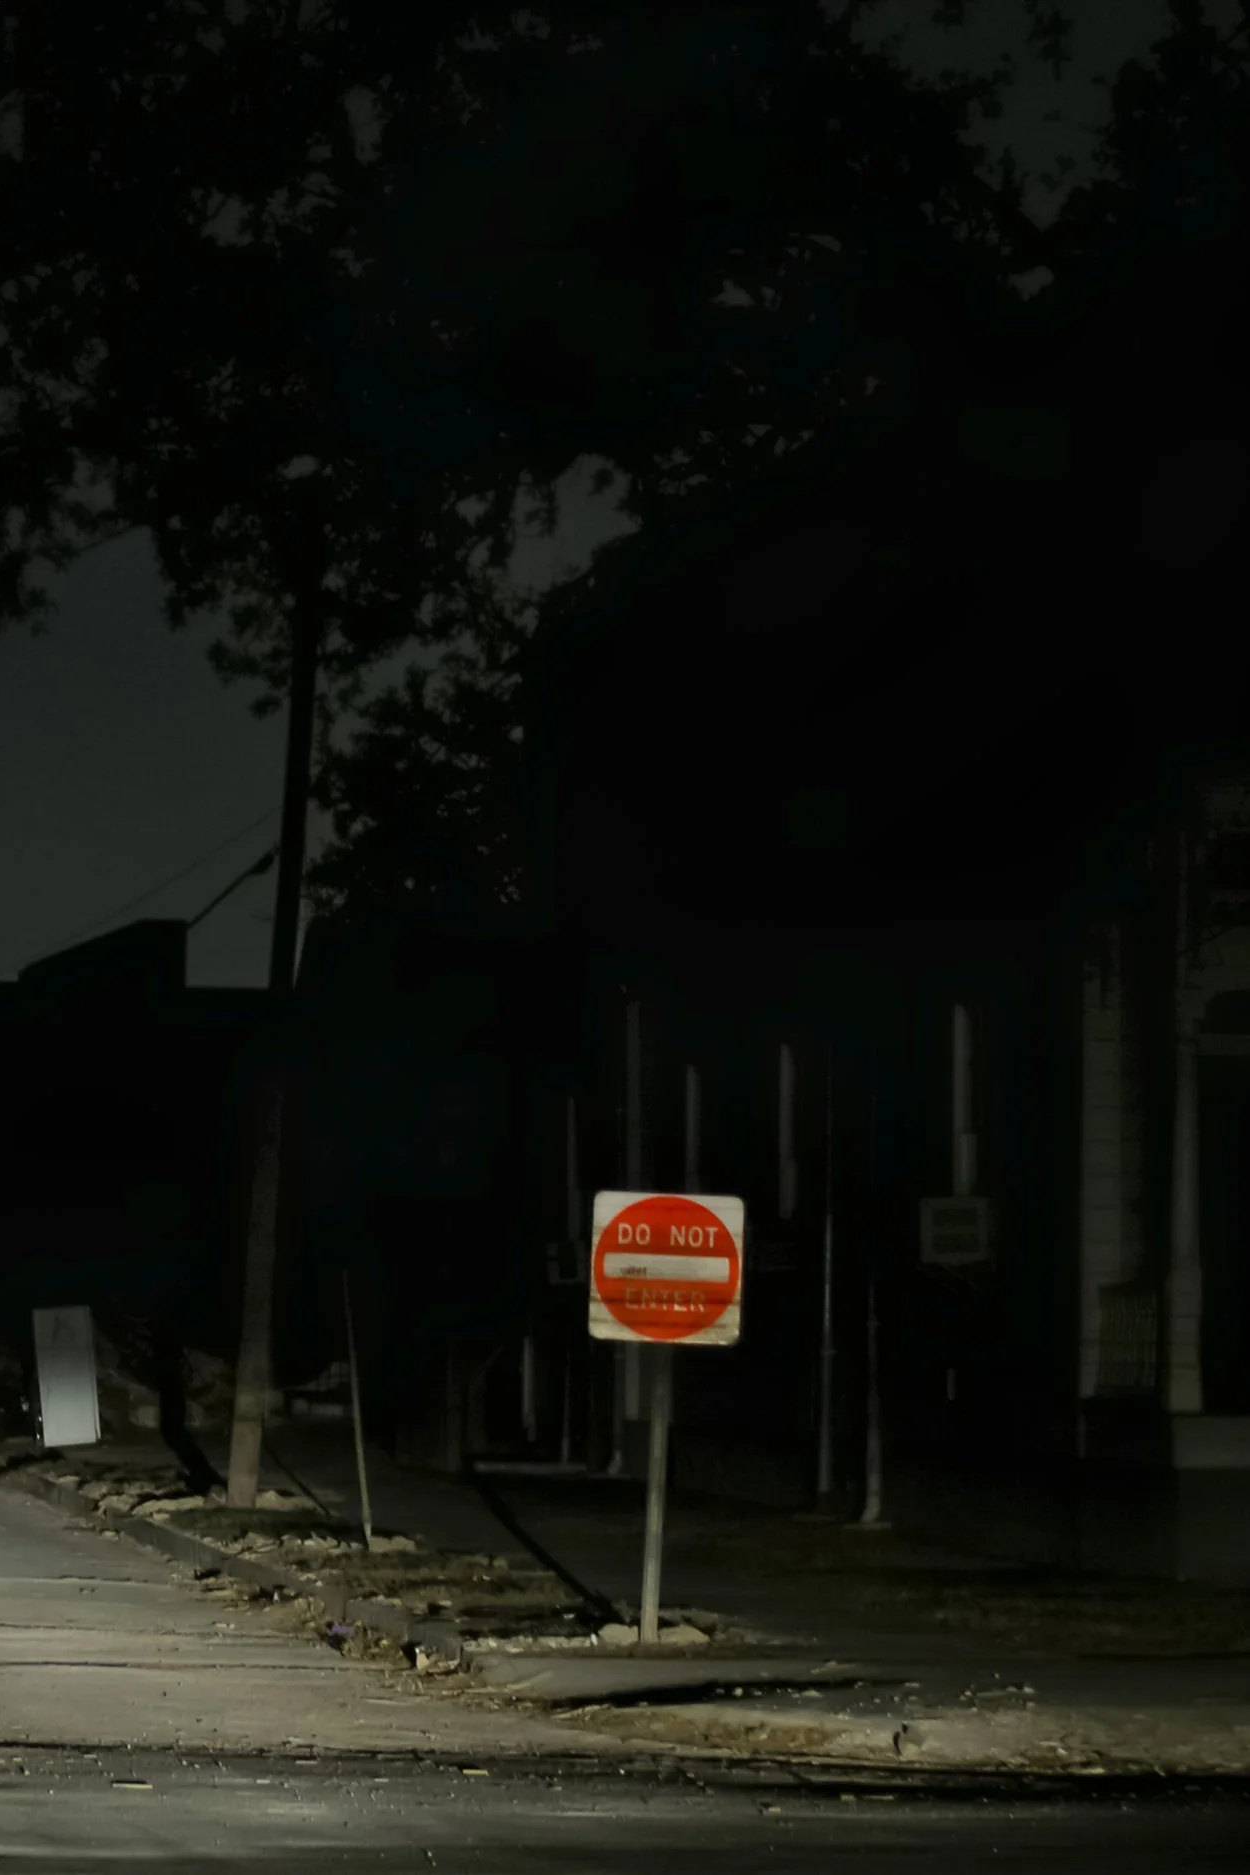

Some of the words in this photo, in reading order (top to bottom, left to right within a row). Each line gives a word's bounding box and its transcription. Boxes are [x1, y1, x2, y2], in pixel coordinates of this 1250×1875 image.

[618, 1222, 650, 1245] DO
[670, 1225, 718, 1248] NOT
[625, 1287, 705, 1312] ENTER
